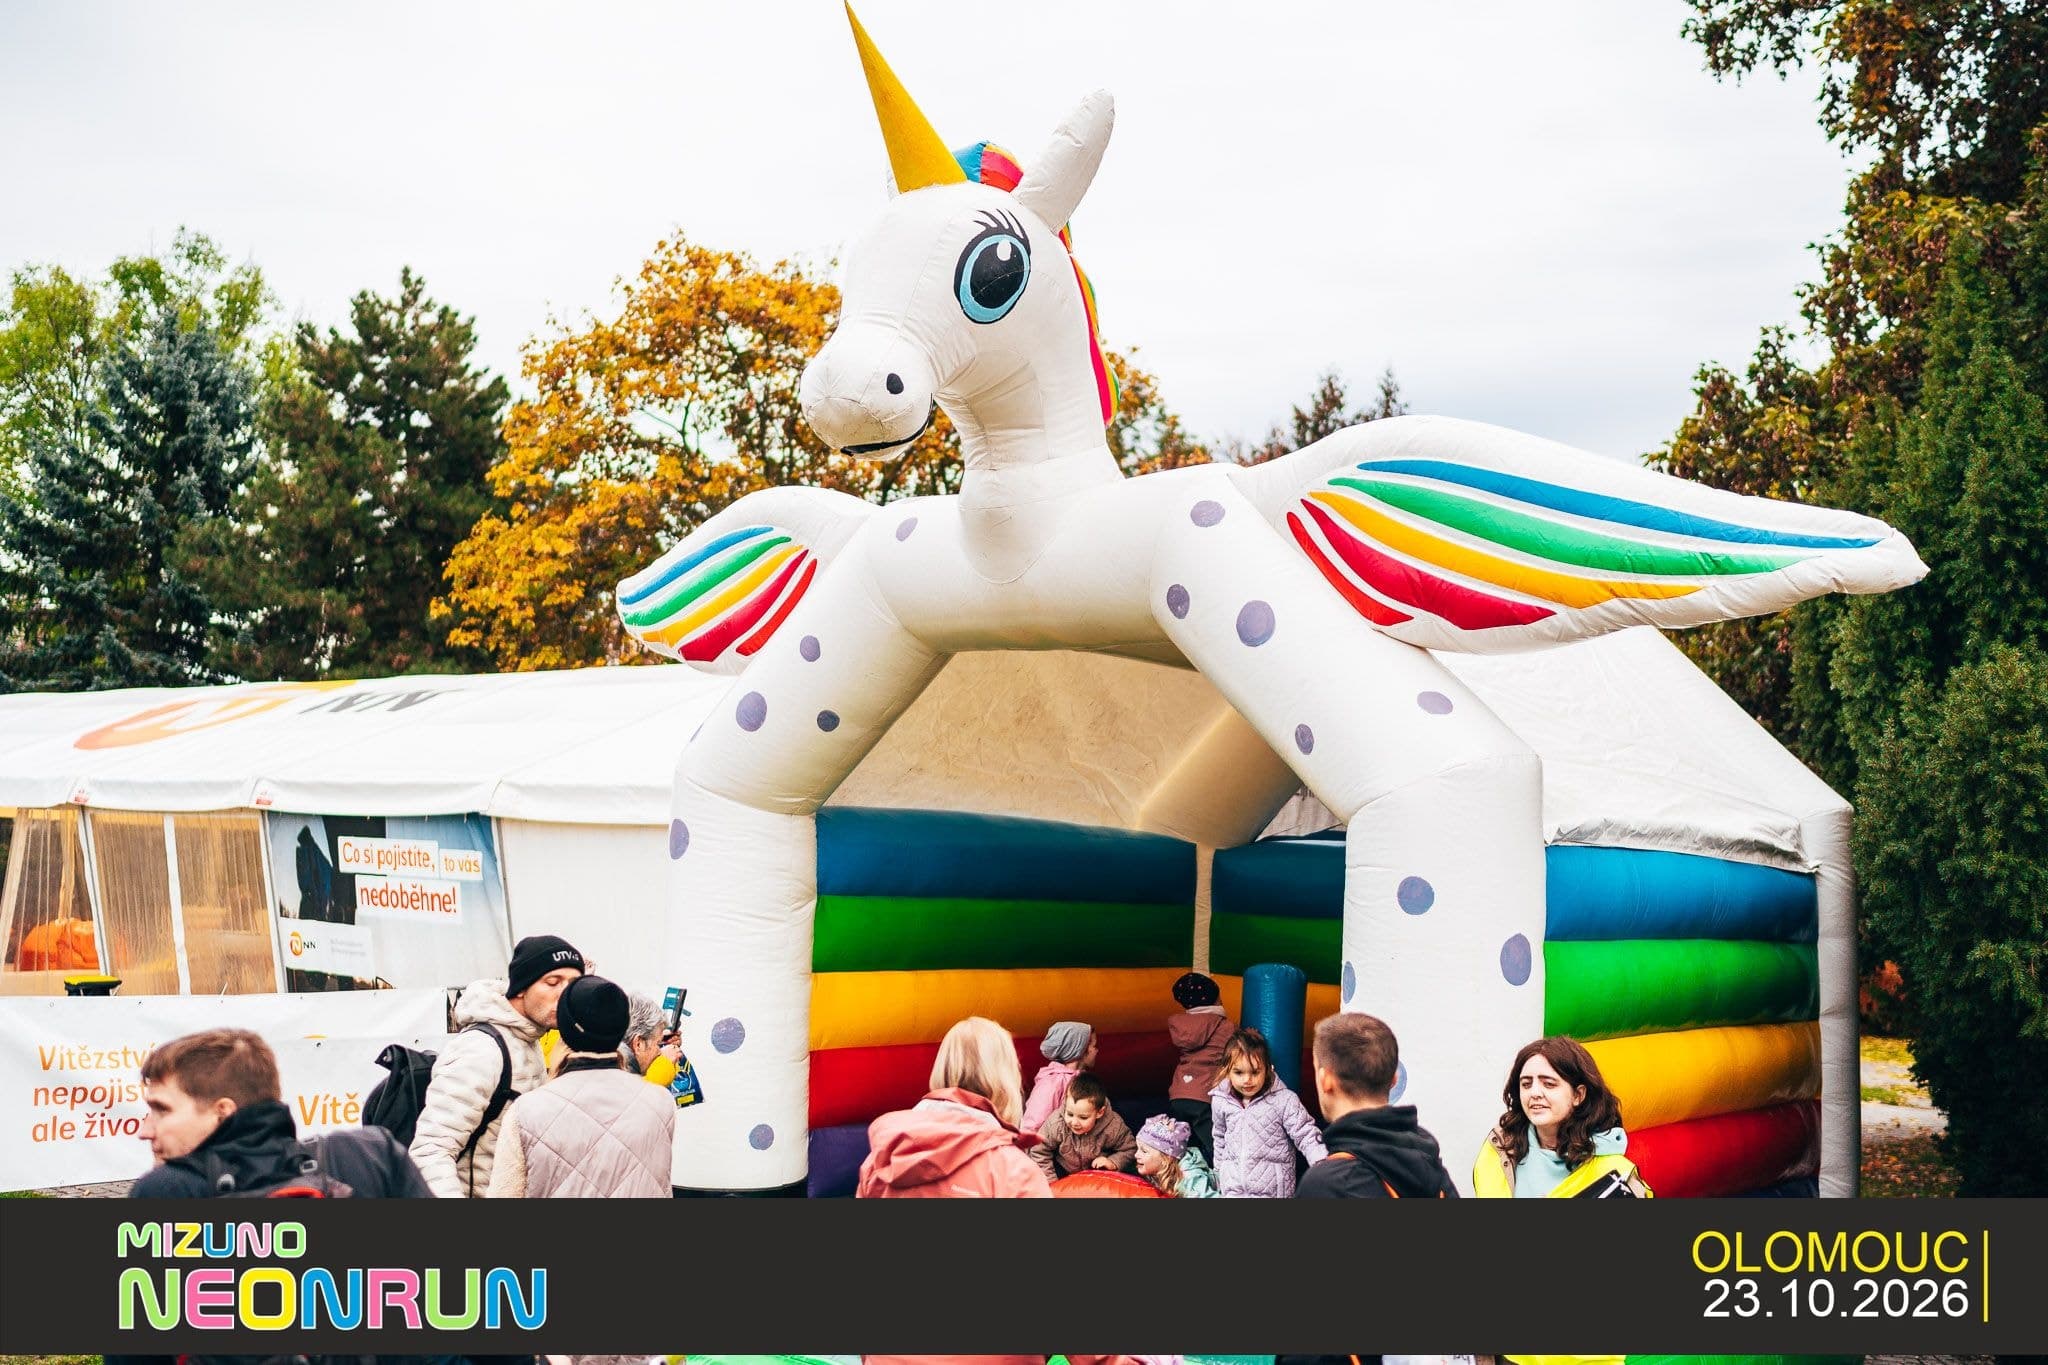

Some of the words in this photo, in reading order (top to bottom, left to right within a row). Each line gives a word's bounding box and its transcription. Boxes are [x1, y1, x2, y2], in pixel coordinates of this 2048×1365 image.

[343, 842, 360, 863] Co
[363, 844, 374, 864] si
[444, 857, 455, 872] to
[459, 855, 480, 873] vás
[360, 881, 457, 914] nedoběhne!
[303, 941, 316, 949] NN
[32, 1115, 76, 1142] ale
[84, 1112, 147, 1138] živo
